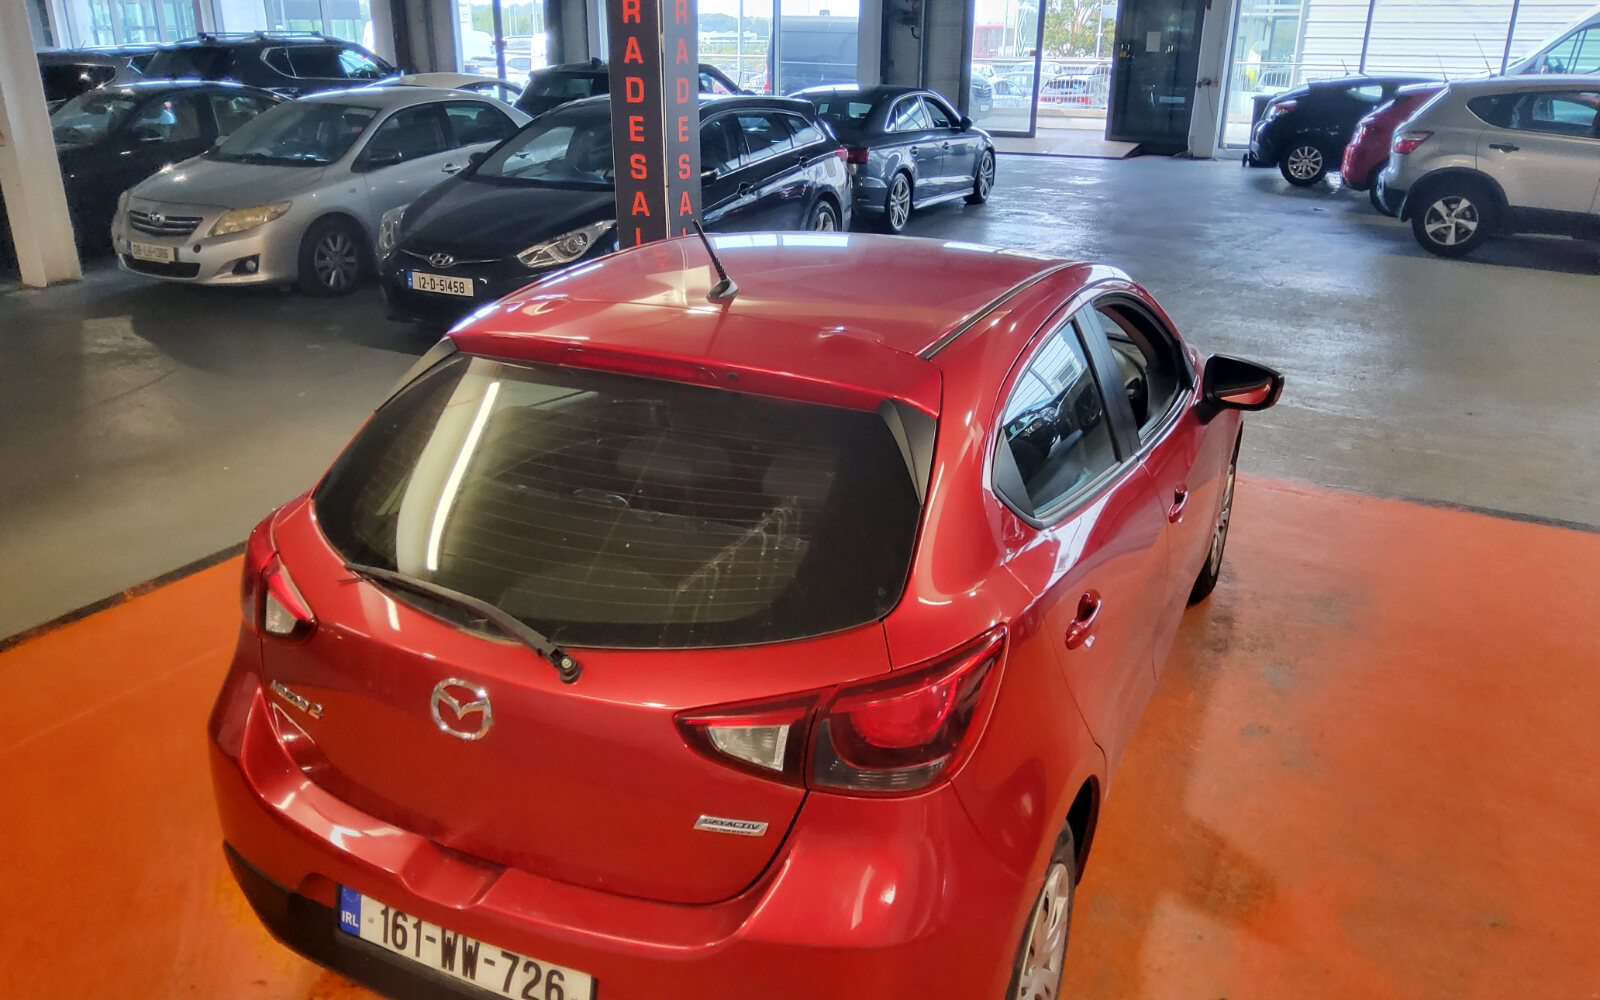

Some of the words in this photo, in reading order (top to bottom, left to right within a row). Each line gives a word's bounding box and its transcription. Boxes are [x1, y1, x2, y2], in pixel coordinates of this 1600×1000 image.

[419, 277, 465, 293] 12-D-51458
[341, 910, 359, 928] IRL
[380, 905, 565, 1000] 161-WW-726
